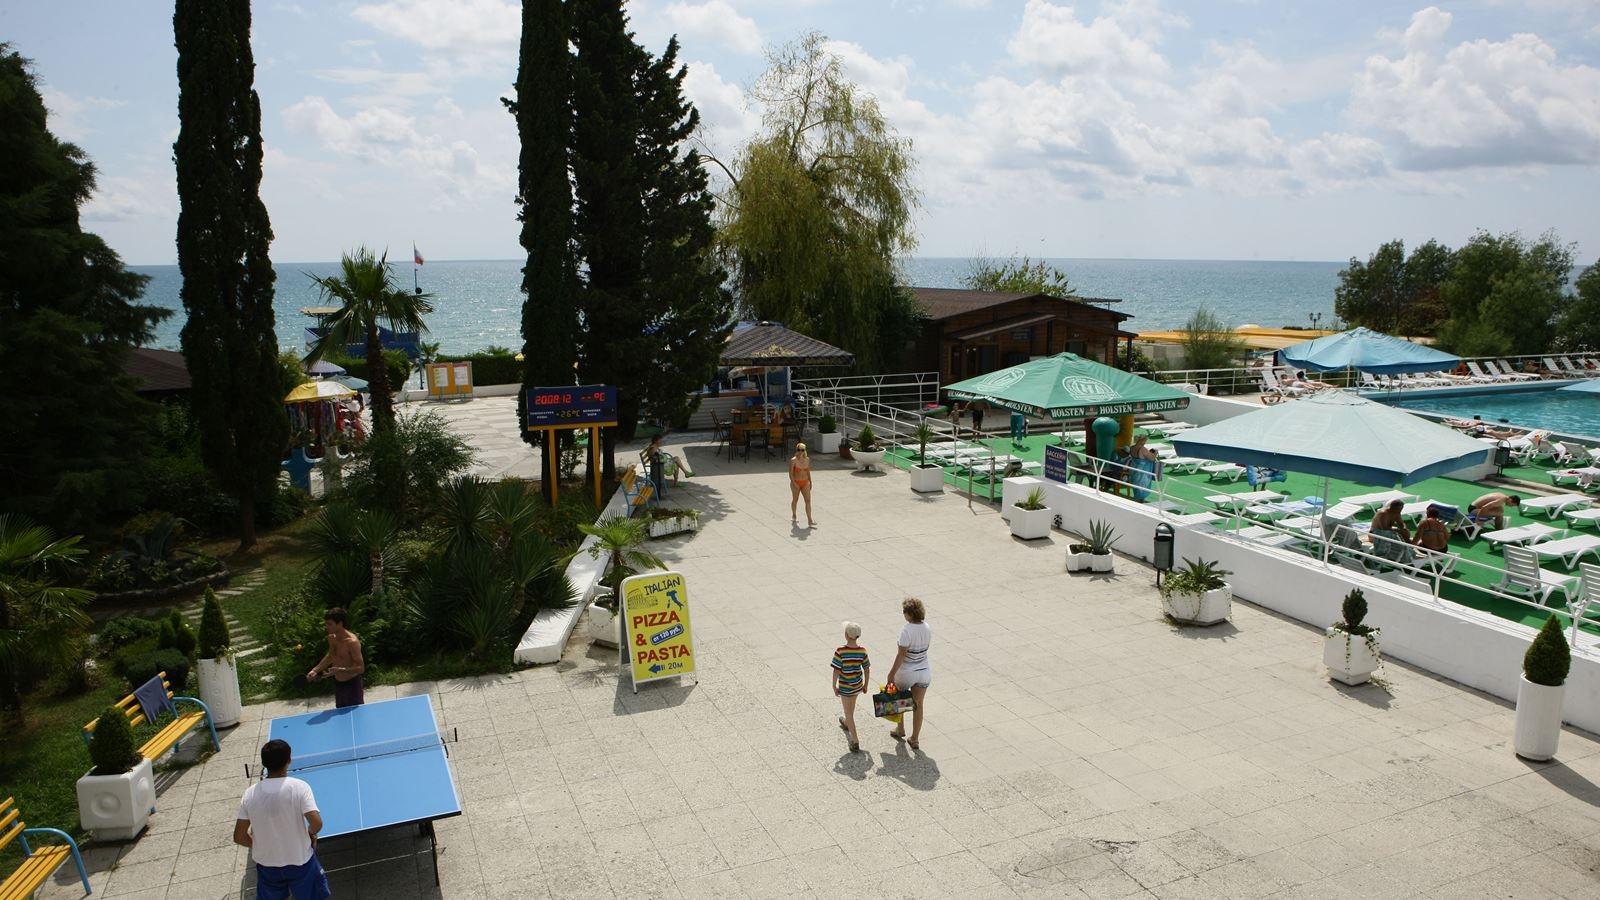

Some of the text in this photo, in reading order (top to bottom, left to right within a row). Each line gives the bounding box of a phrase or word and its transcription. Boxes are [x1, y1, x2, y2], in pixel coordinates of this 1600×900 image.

[1005, 401, 1033, 414] HOLSTEN
[1051, 407, 1085, 418] HOLSTEN
[1099, 404, 1132, 415] HOLSTEN
[1146, 400, 1176, 411] HOLSTEN
[644, 576, 680, 595] ITALIAN
[633, 610, 680, 629] PIZZA
[635, 633, 647, 646] &
[637, 644, 690, 664] PASTA
